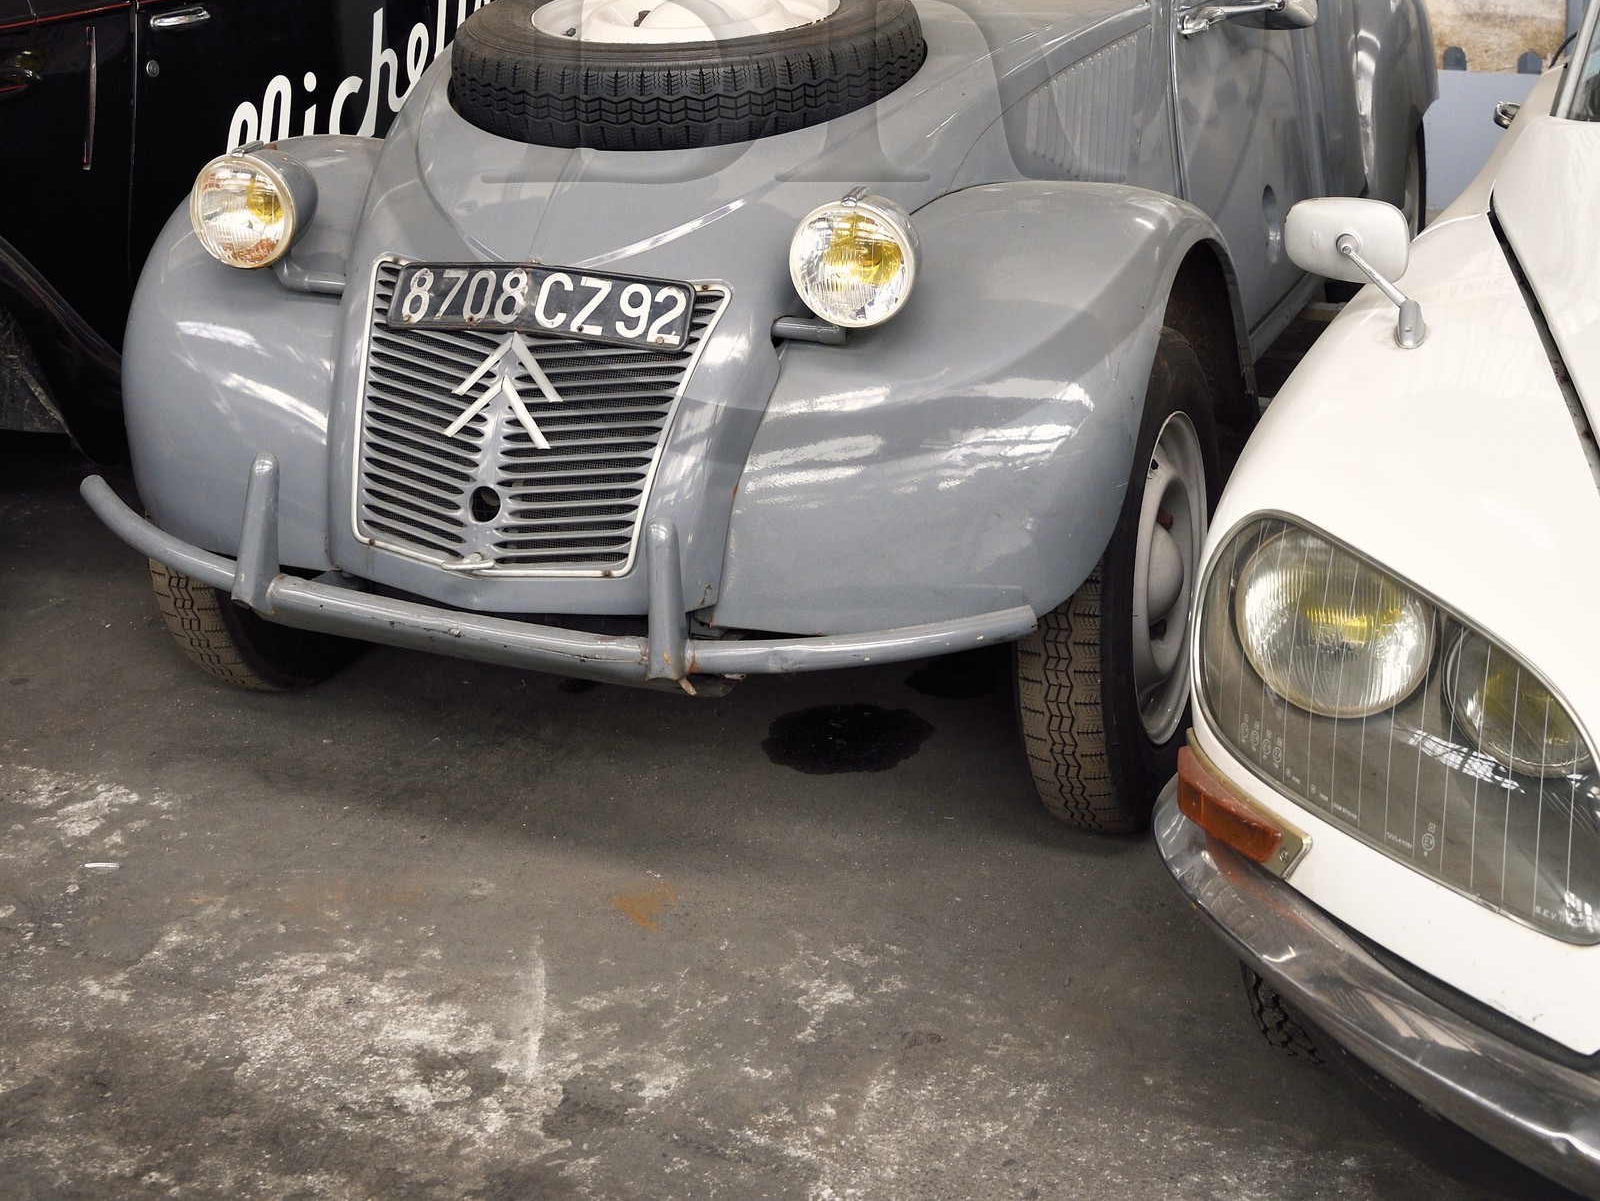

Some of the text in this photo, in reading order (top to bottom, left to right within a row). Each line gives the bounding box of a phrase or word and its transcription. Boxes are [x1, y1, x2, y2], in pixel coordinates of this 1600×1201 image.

[401, 266, 688, 345] 8708 CZ 92
